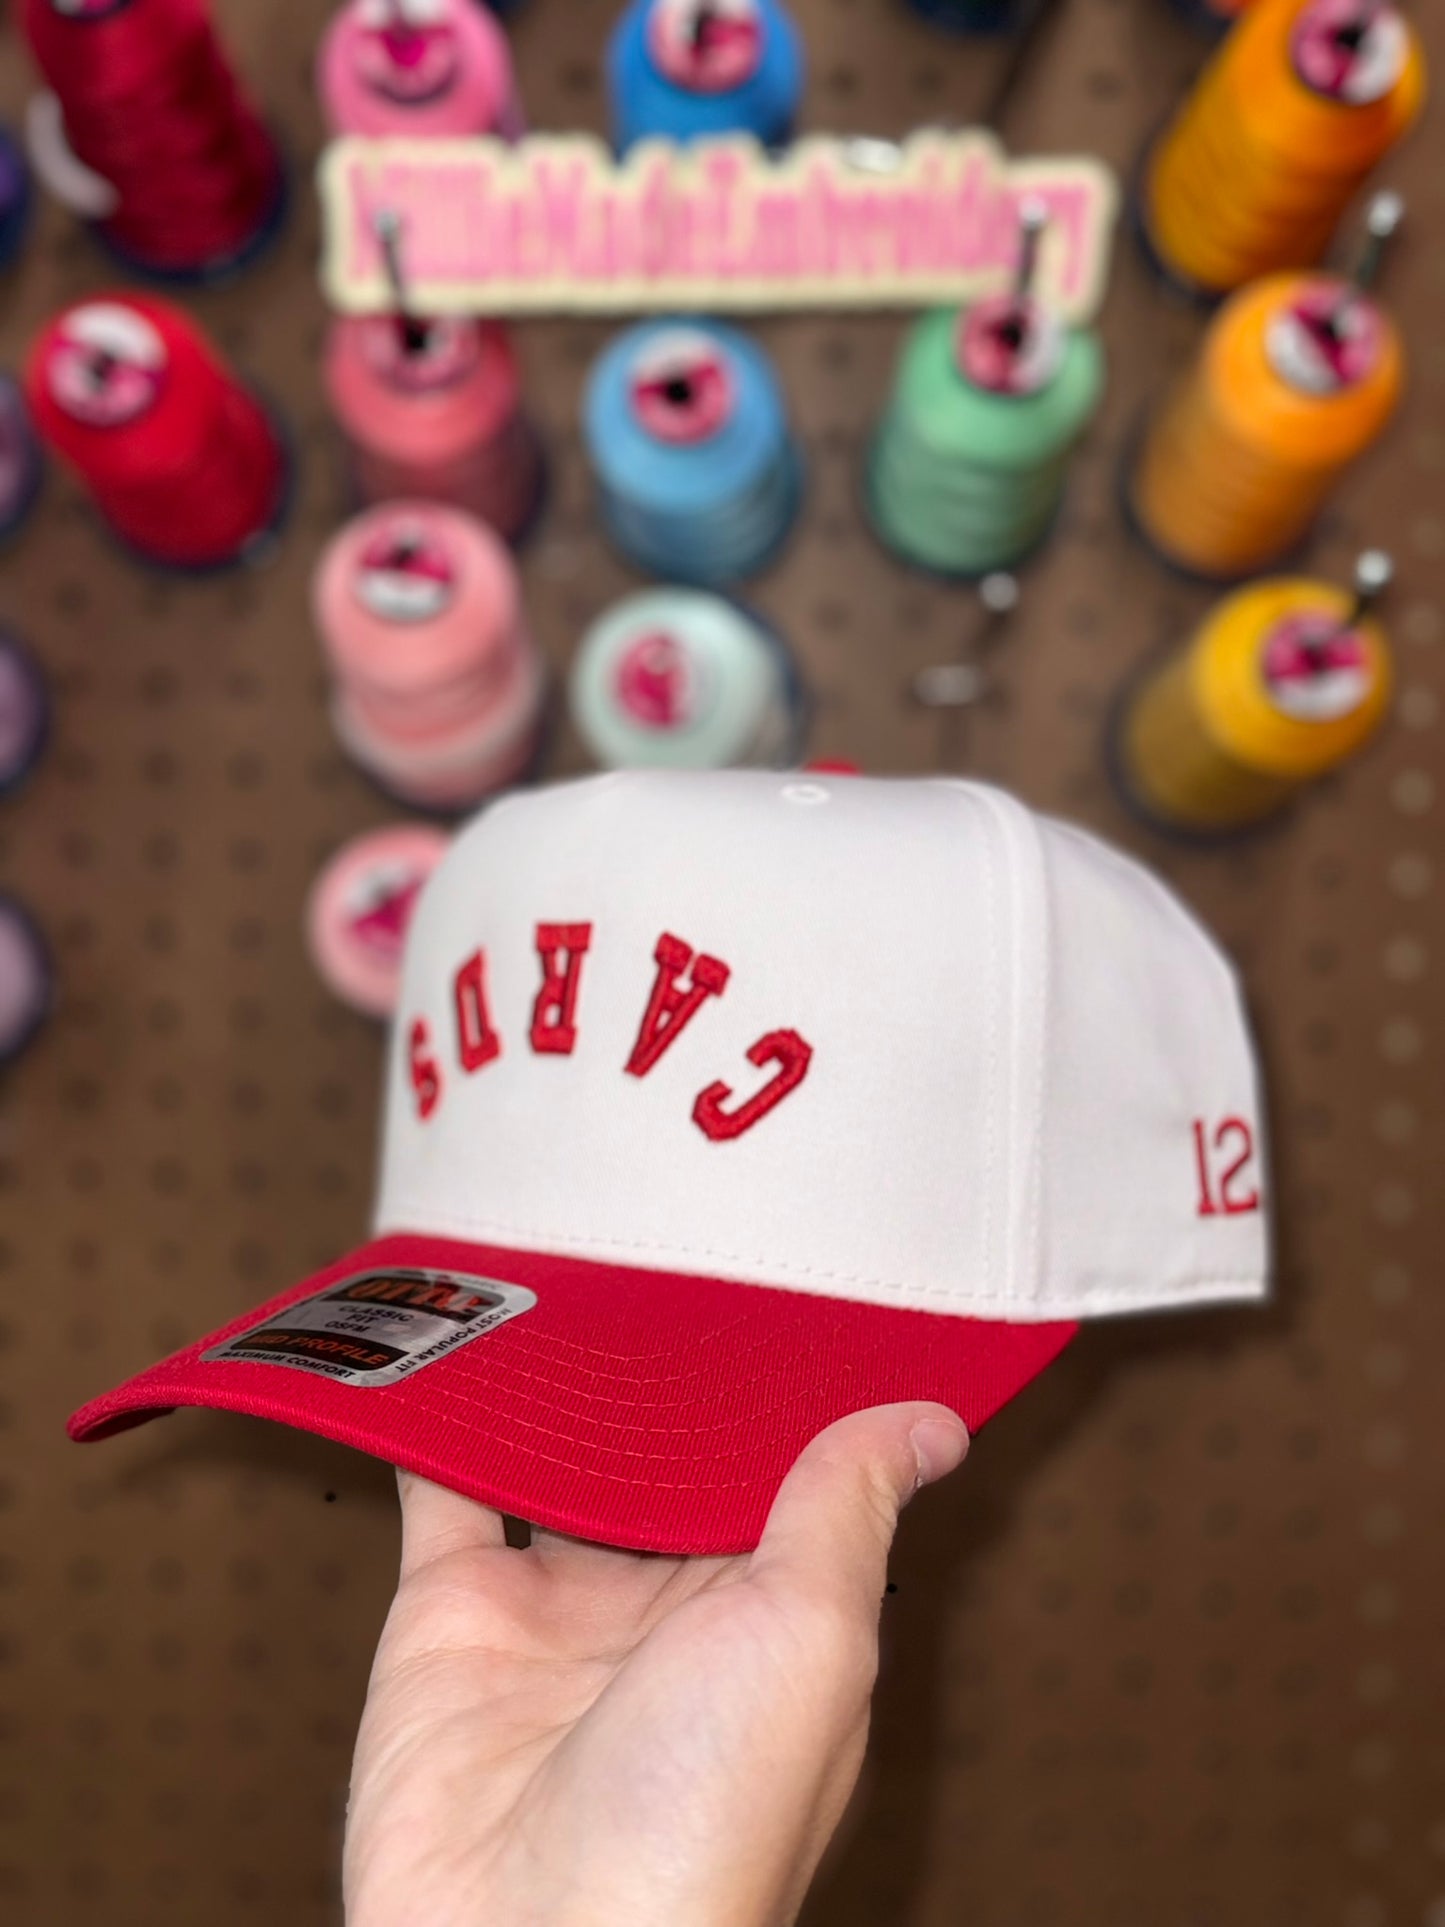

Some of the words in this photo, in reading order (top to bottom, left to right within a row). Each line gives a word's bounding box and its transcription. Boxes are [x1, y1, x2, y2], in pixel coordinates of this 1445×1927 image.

[408, 919, 815, 1144] CARDS
[1192, 1114, 1260, 1217] 12
[338, 1304, 415, 1322] CLASSIC
[345, 1313, 379, 1324] FIT
[474, 1307, 513, 1330] MOST
[289, 1336, 390, 1366] PROFILE
[413, 1326, 478, 1361] POPULAR
[218, 1351, 286, 1362] MAXIMUM
[286, 1356, 356, 1379] COMFORT
[394, 1359, 418, 1373] FIT
